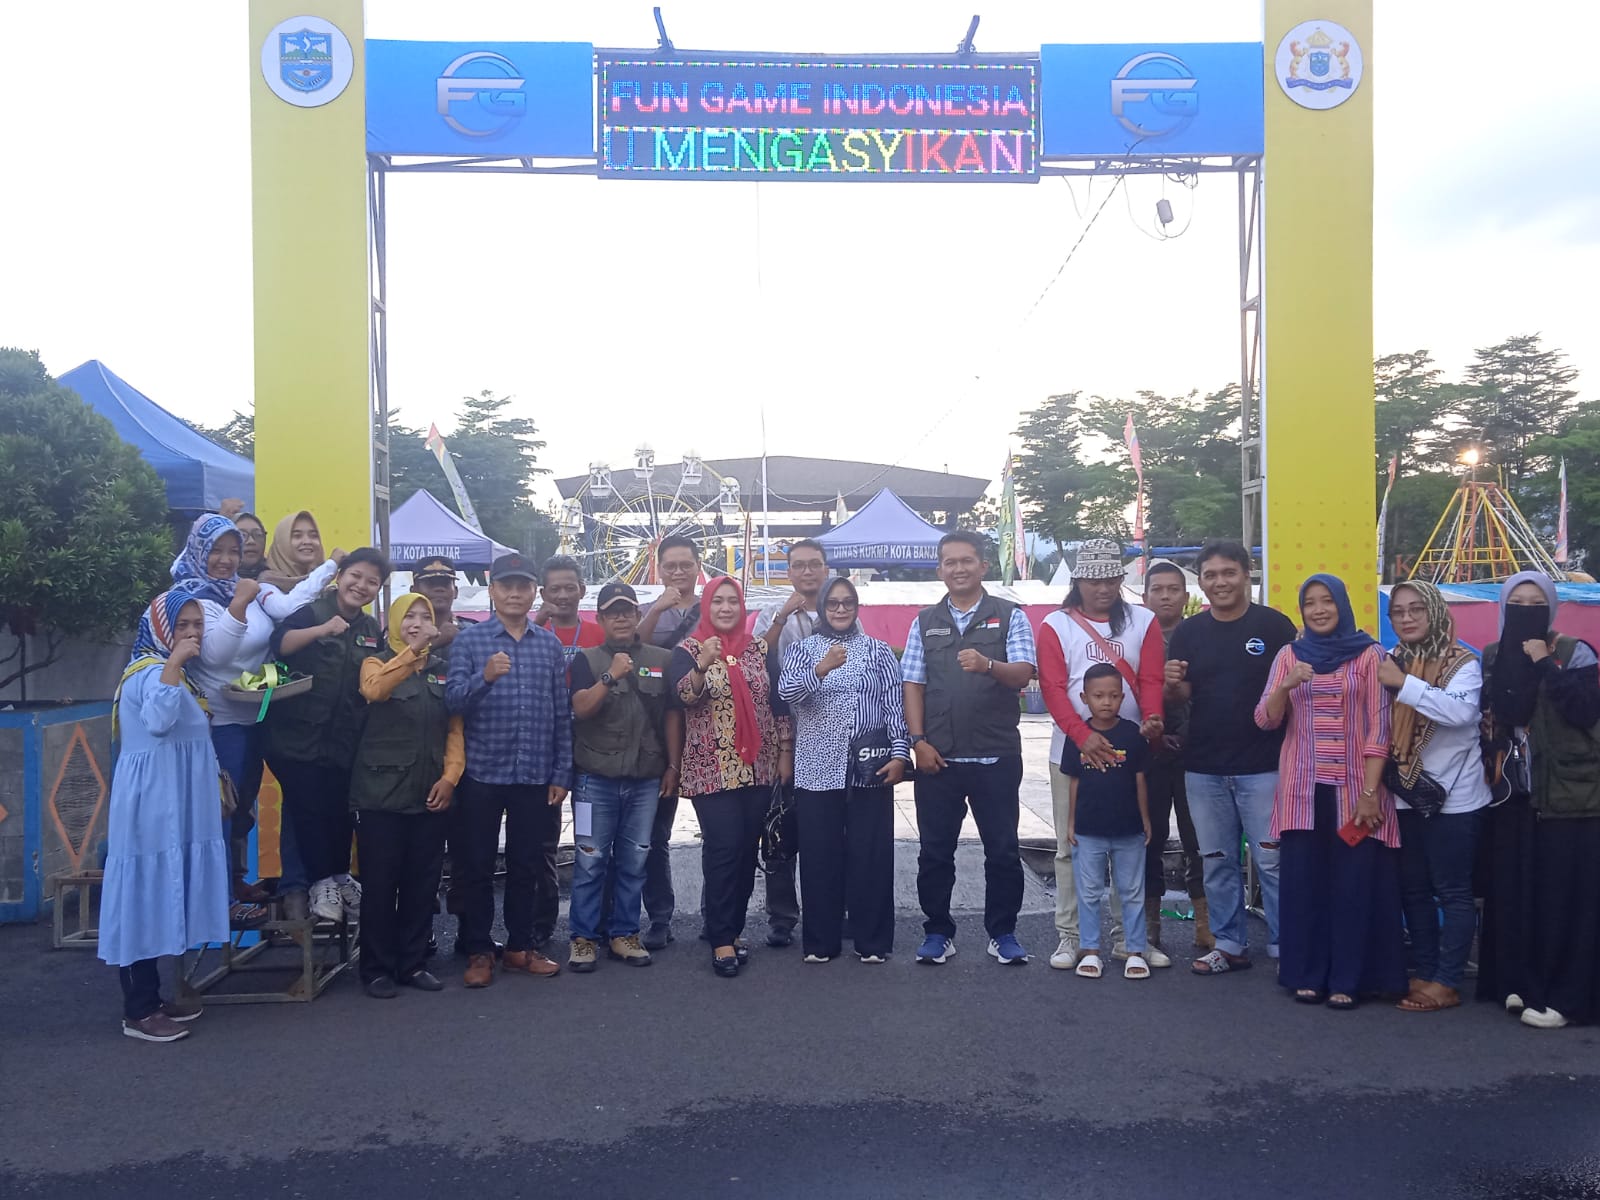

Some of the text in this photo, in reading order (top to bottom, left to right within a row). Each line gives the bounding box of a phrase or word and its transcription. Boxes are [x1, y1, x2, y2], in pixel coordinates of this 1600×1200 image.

[612, 81, 1029, 116] FUN GAME INDONESIA
[655, 129, 1023, 172] MENGASYIKAN
[391, 545, 460, 560] MP KOTA BANJAR
[833, 545, 858, 560] DINAS
[890, 545, 911, 560] KOTA
[913, 545, 938, 561] BANJA
[858, 746, 892, 762] Supr
